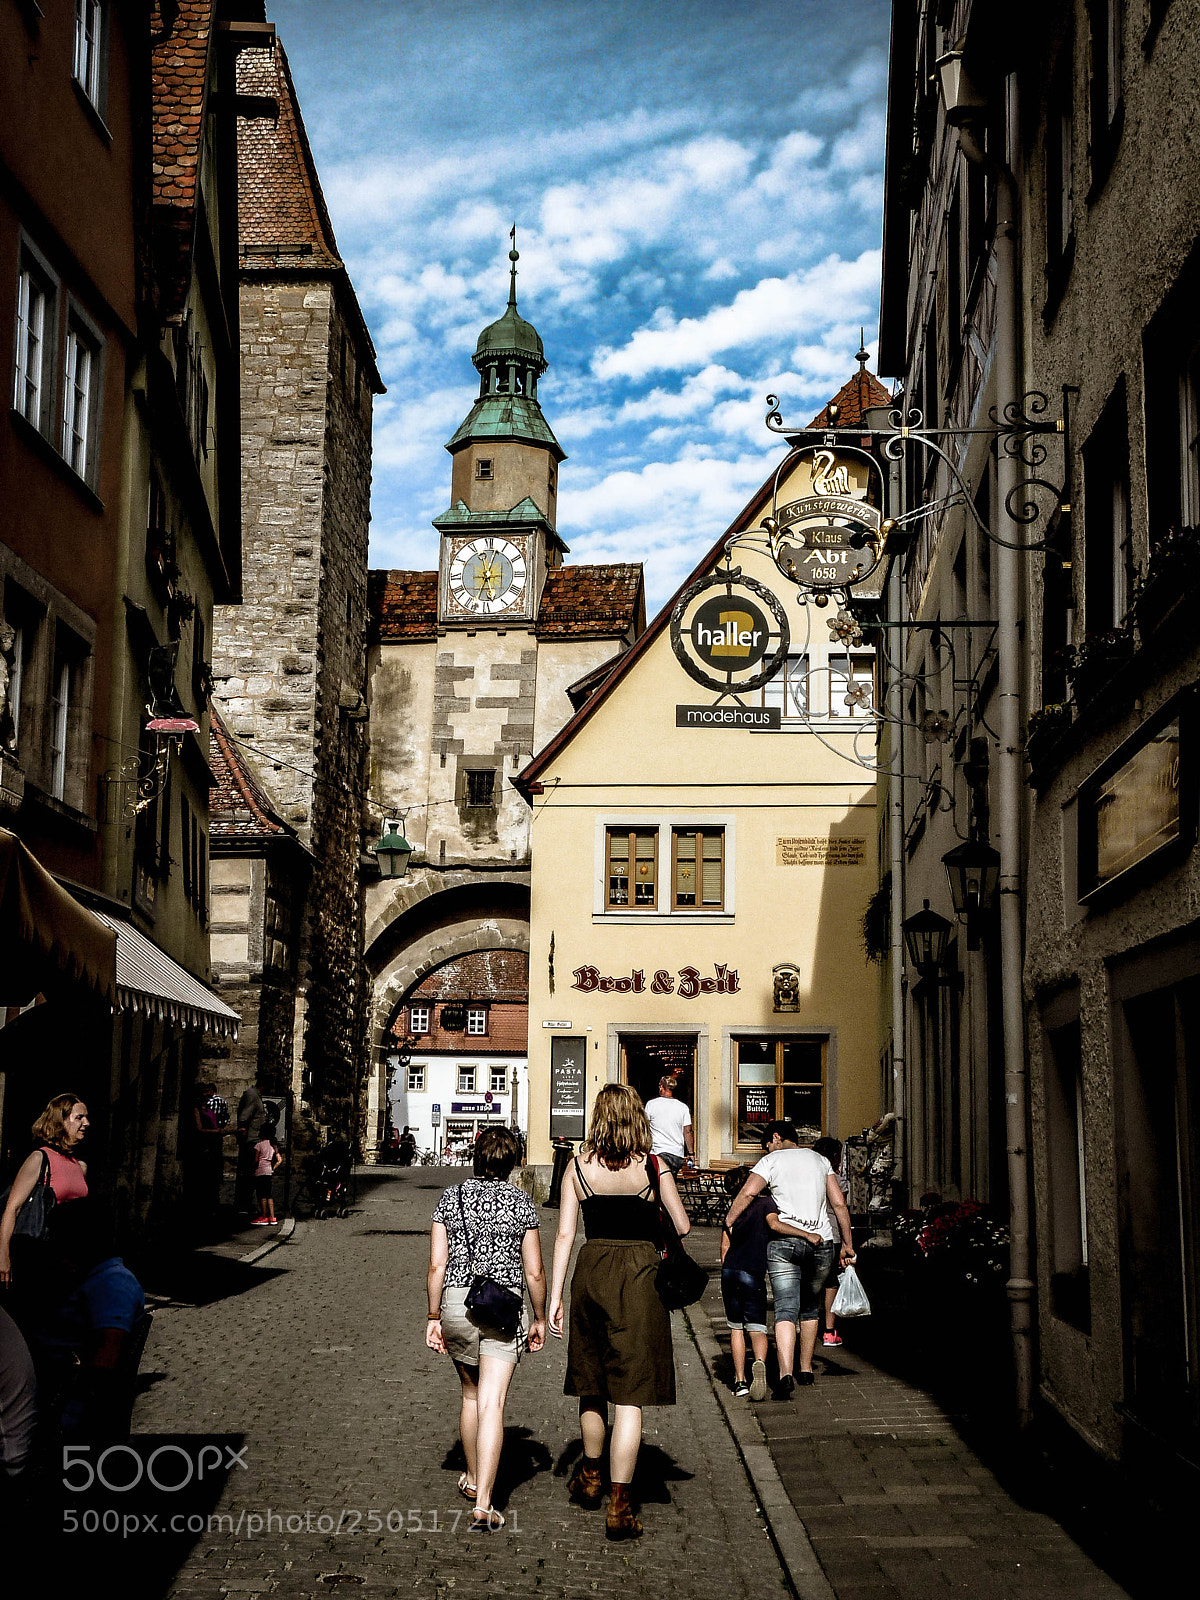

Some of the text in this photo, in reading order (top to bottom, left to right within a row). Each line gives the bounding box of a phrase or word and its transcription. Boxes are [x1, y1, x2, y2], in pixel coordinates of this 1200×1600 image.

[786, 500, 871, 520] Kunstgewerbe
[812, 531, 842, 543] Klaus
[803, 549, 848, 564] Abt
[811, 568, 837, 579] 1658
[697, 621, 762, 647] haller
[687, 709, 770, 724] modehaus
[571, 963, 741, 999] Brot & Zeit
[746, 1098, 769, 1106] Mehl,
[746, 1105, 769, 1113] Butter,
